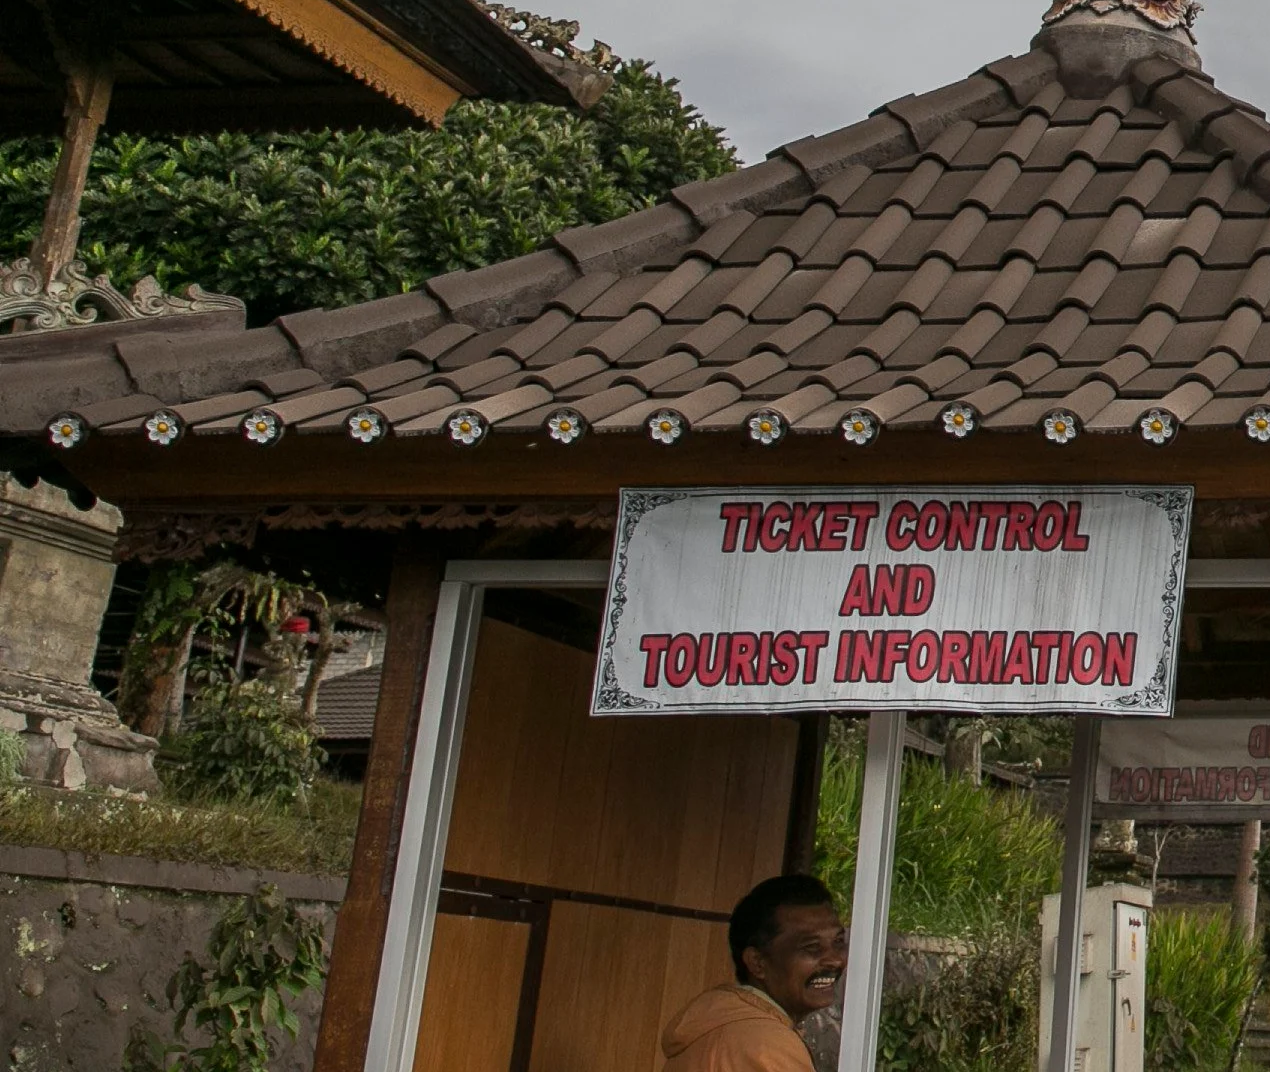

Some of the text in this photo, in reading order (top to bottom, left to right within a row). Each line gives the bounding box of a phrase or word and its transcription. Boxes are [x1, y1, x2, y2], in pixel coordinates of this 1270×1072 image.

[721, 500, 1090, 553] TICKET CONTROL
[838, 564, 935, 616] AND
[640, 630, 1137, 688] TOURIST INFORMATION
